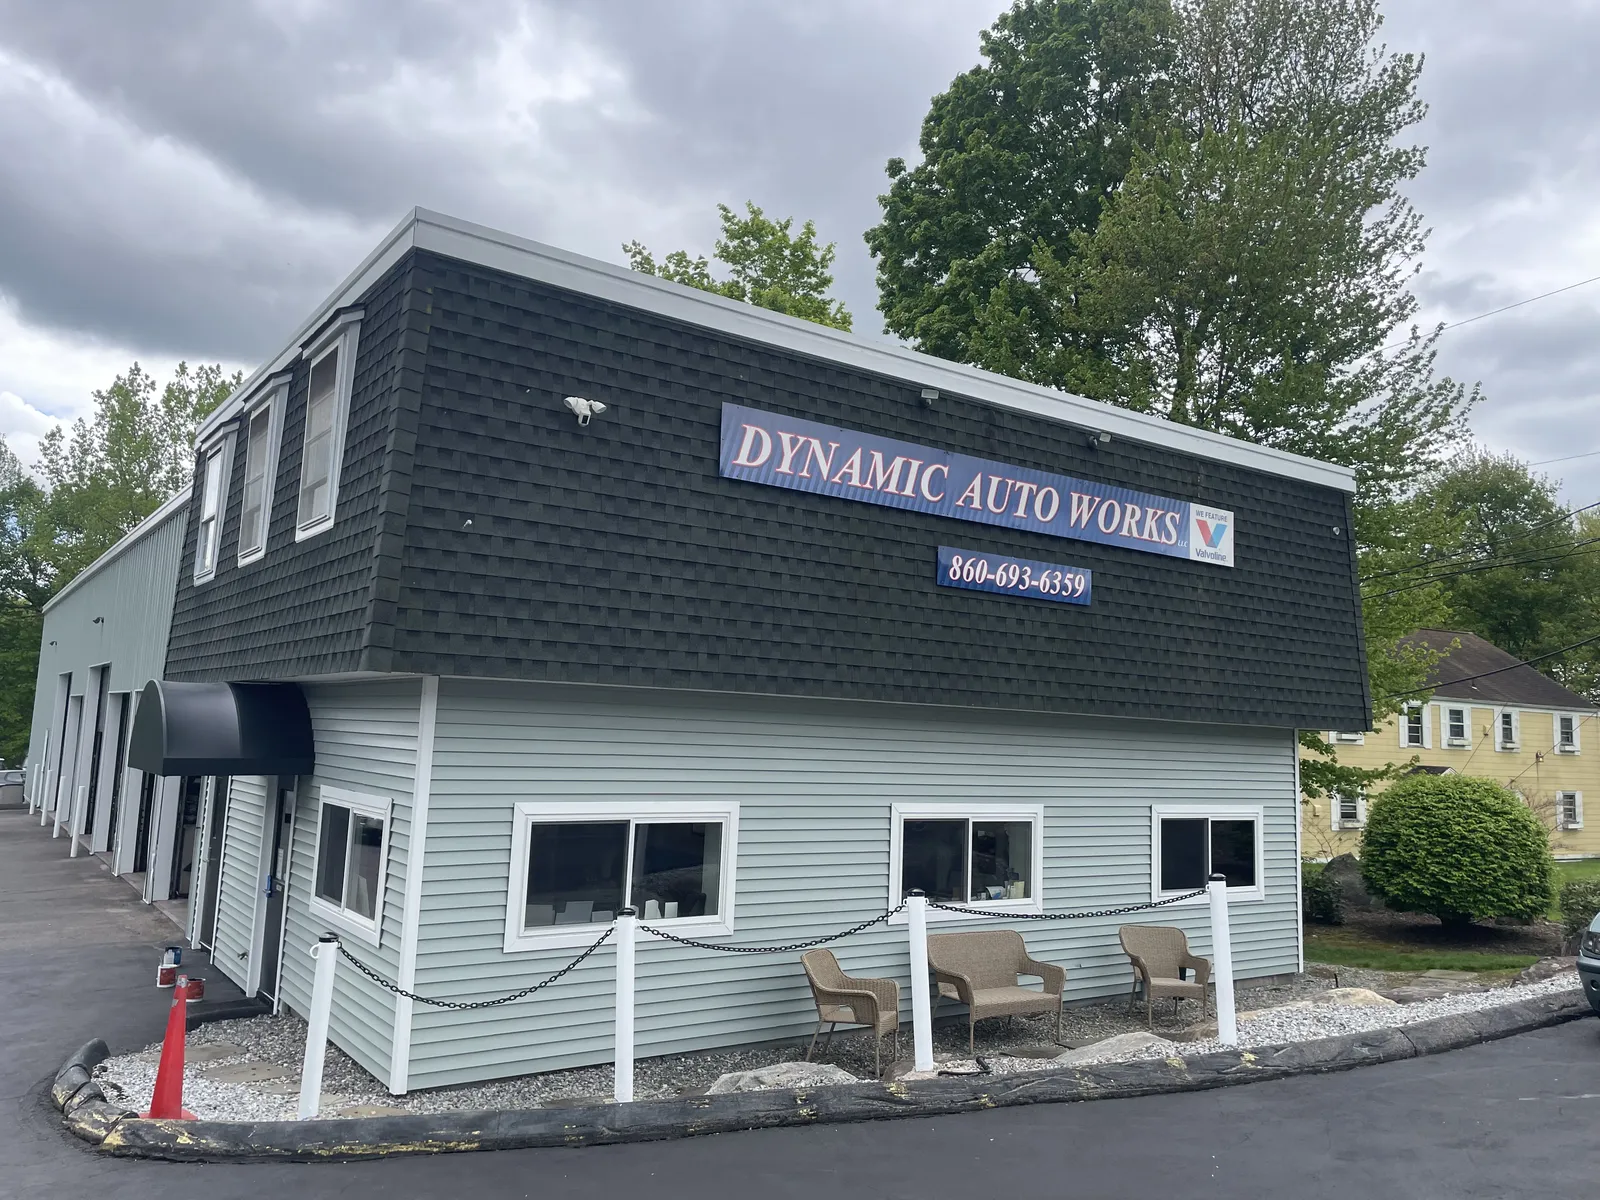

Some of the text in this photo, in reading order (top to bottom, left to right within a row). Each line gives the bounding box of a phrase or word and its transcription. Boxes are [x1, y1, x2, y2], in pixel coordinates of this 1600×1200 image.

[732, 423, 949, 503] DYNAMIC
[955, 471, 1060, 522] AUTO
[1069, 491, 1181, 546] WORKS
[1205, 512, 1228, 522] FEATURE
[1195, 548, 1227, 561] Valvoline
[949, 555, 1085, 598] 860-693-6359
